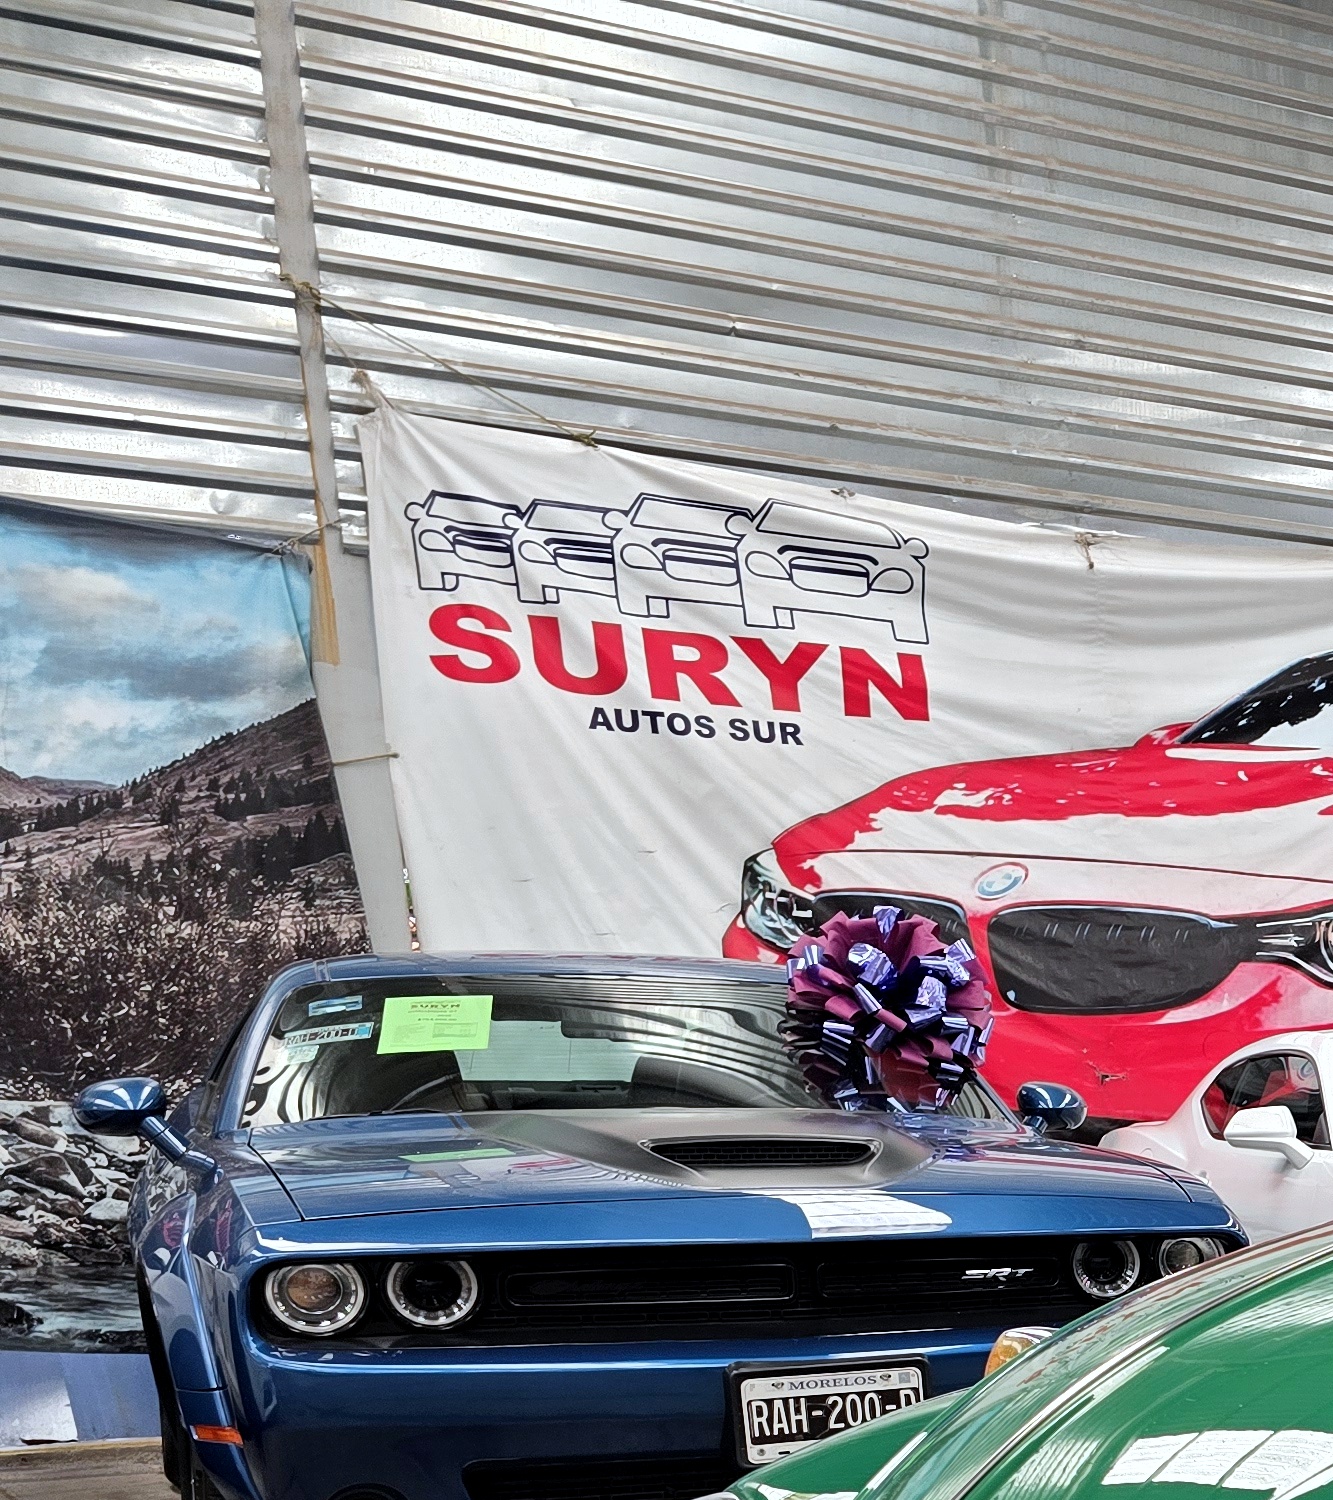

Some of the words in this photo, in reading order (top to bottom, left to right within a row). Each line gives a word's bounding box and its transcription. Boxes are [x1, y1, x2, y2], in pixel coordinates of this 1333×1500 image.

[428, 603, 931, 722] SURYN
[588, 706, 716, 738] AUTOS
[728, 720, 804, 746] SUR
[962, 1267, 1034, 1281] SRT
[788, 1375, 877, 1391] MORELOS
